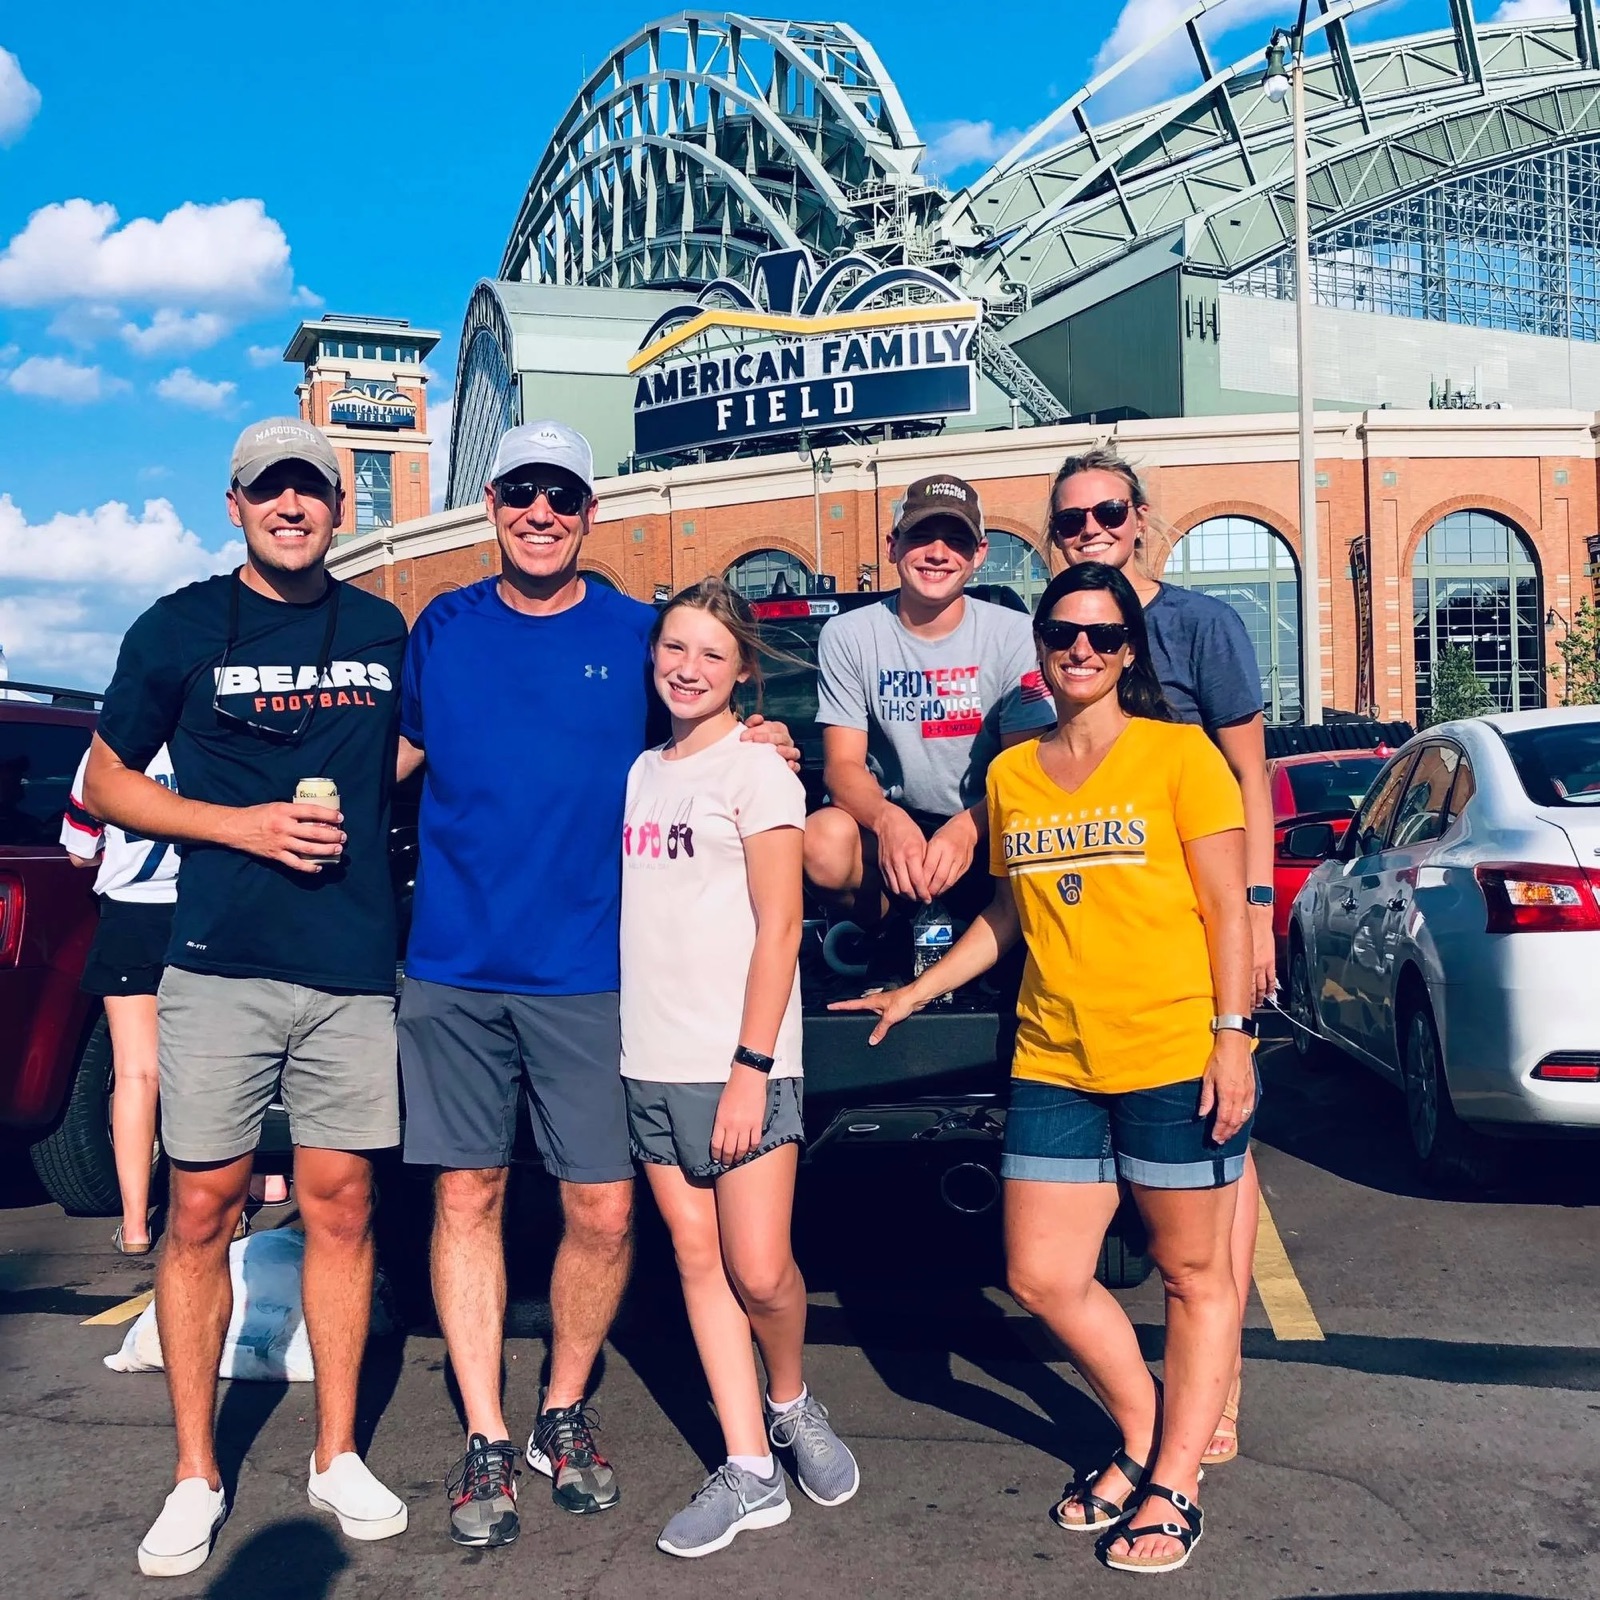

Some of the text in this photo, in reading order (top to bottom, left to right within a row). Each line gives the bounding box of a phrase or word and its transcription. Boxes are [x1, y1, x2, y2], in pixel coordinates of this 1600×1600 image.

[634, 327, 969, 408] AMERICAN FAMILY
[331, 403, 416, 416] AMERICAN FAMILY
[356, 413, 391, 423] FIELD
[716, 381, 853, 431] FIELD
[255, 426, 317, 443] MARQUETTE
[540, 431, 558, 440] UA
[213, 660, 393, 696] BEARS
[879, 666, 979, 698] PROTECT
[254, 691, 375, 712] FOOTBALL
[881, 697, 982, 722] THIS HOUSE
[1010, 804, 1135, 828] MILWAUKEE
[1003, 819, 1146, 860] BREWERS
